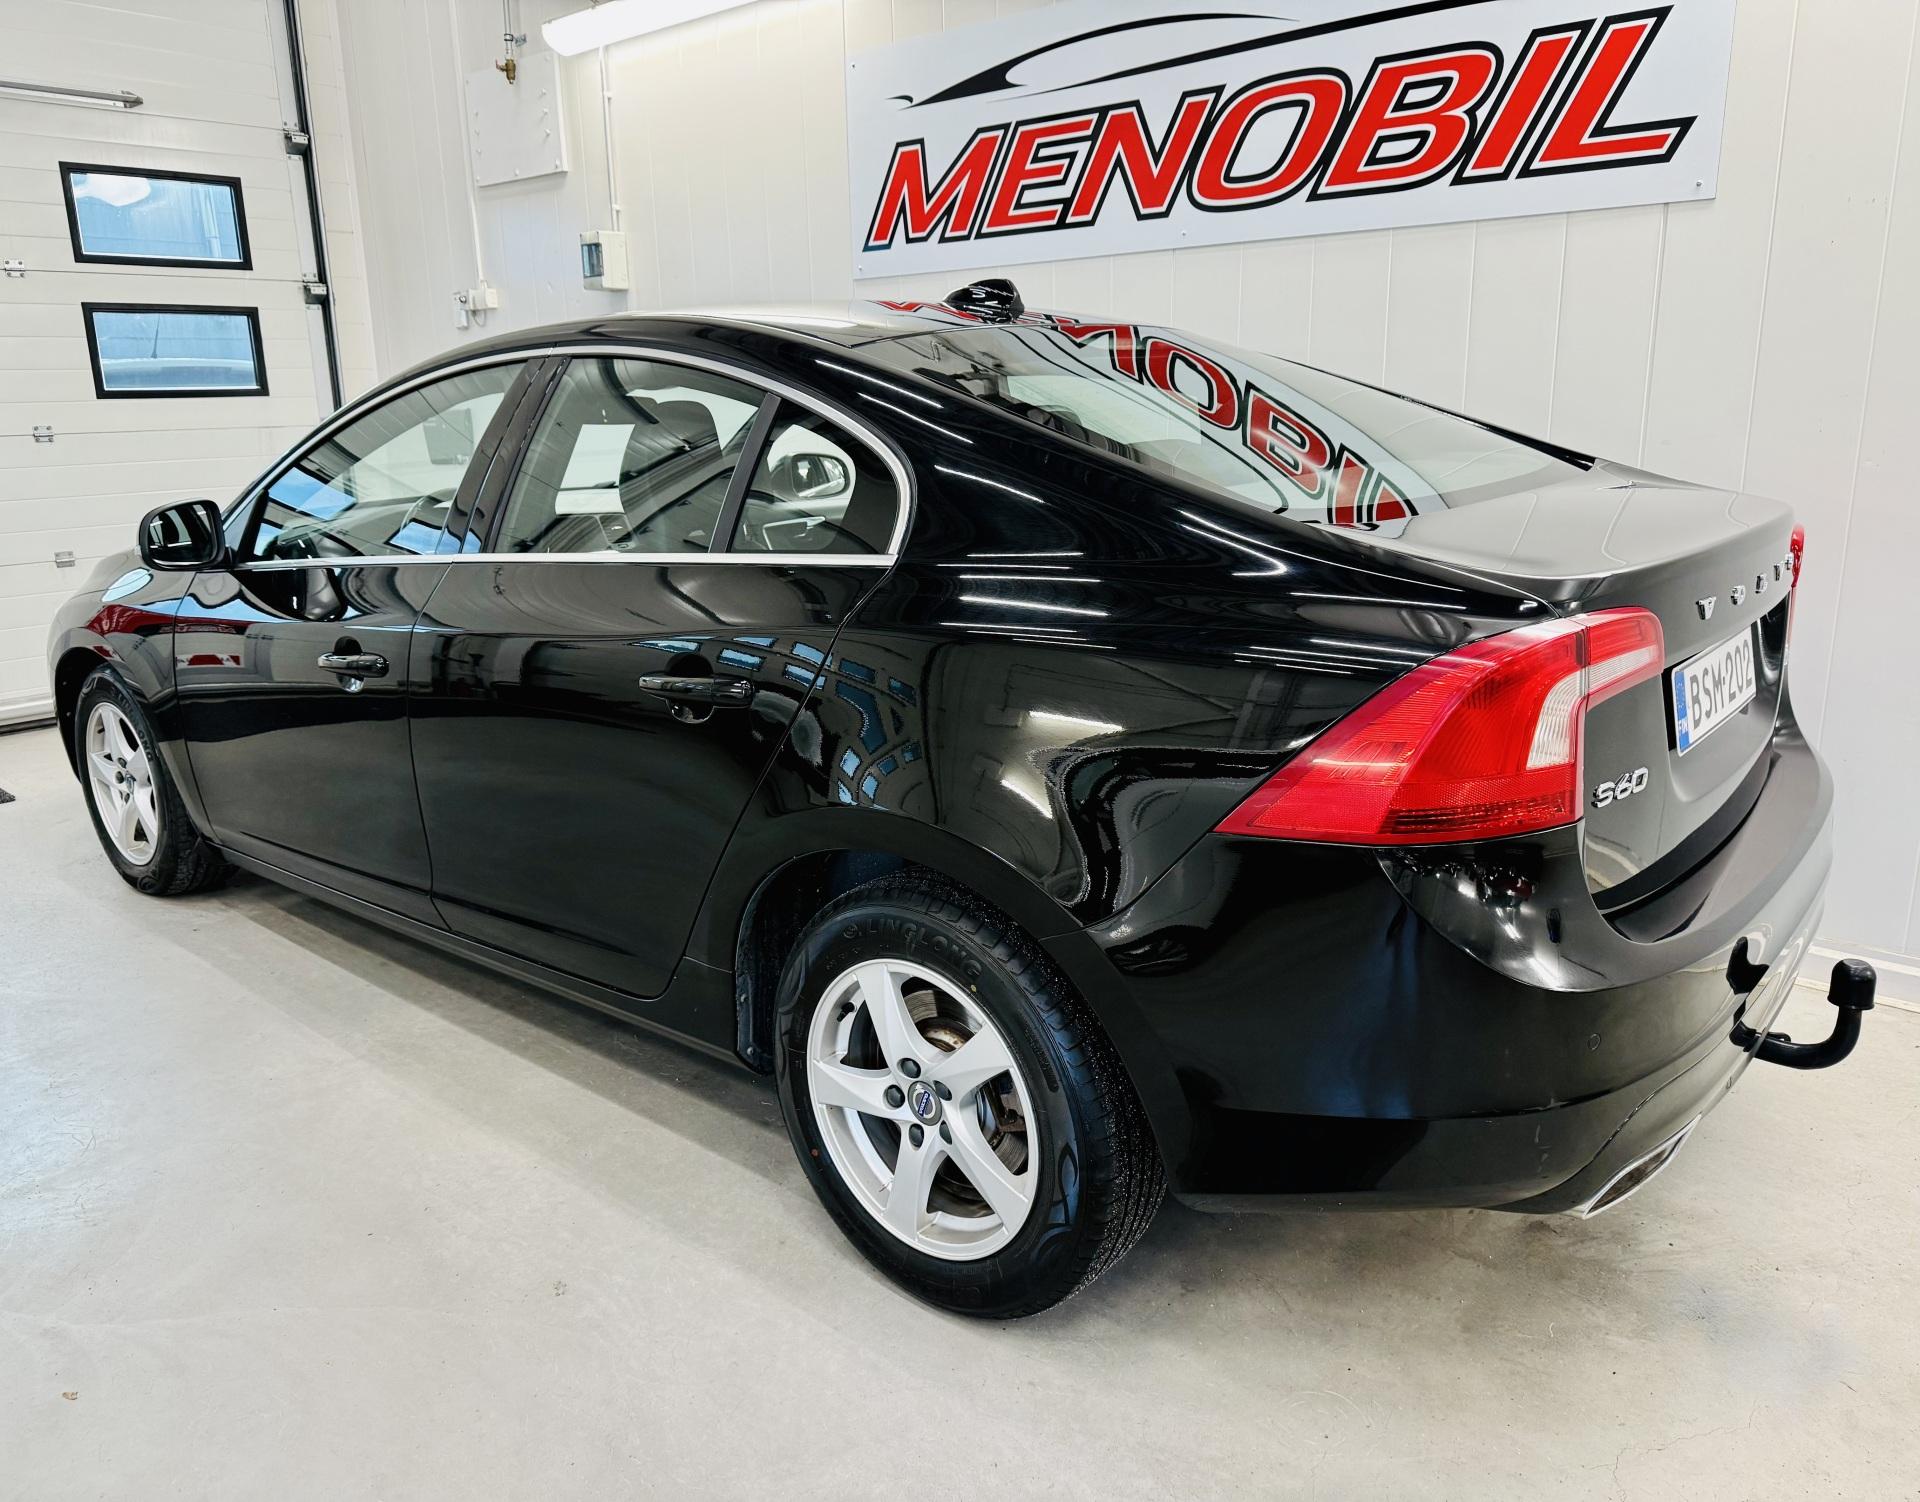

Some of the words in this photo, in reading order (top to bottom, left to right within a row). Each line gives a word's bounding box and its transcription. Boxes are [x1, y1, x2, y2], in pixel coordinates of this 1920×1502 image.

[861, 4, 1698, 253] MENOBIL
[1689, 639, 1753, 730] BSM-202
[1591, 766, 1649, 808] S60
